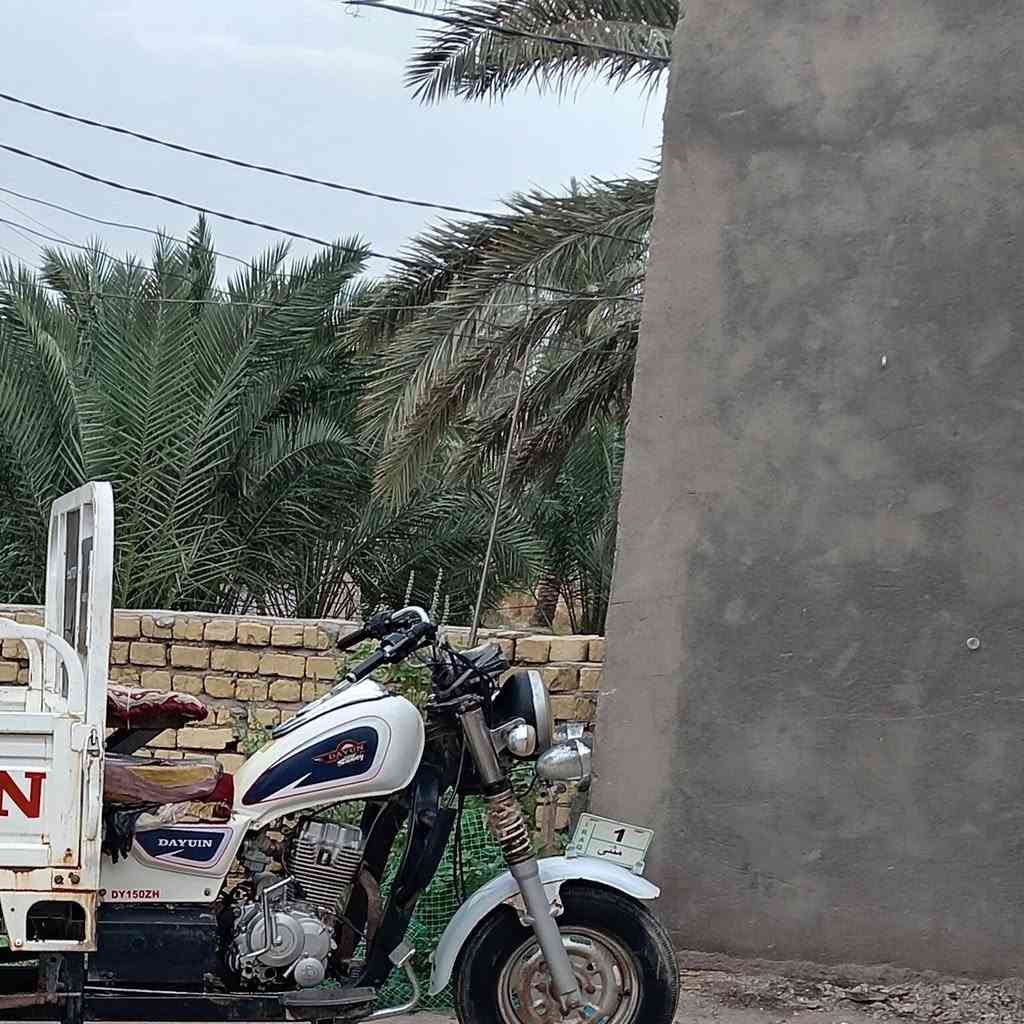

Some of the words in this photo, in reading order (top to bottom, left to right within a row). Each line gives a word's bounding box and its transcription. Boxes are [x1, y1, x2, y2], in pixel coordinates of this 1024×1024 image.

[613, 828, 626, 843] 1
[158, 838, 213, 849] DAYUIN
[111, 890, 160, 899] DY150ZH
